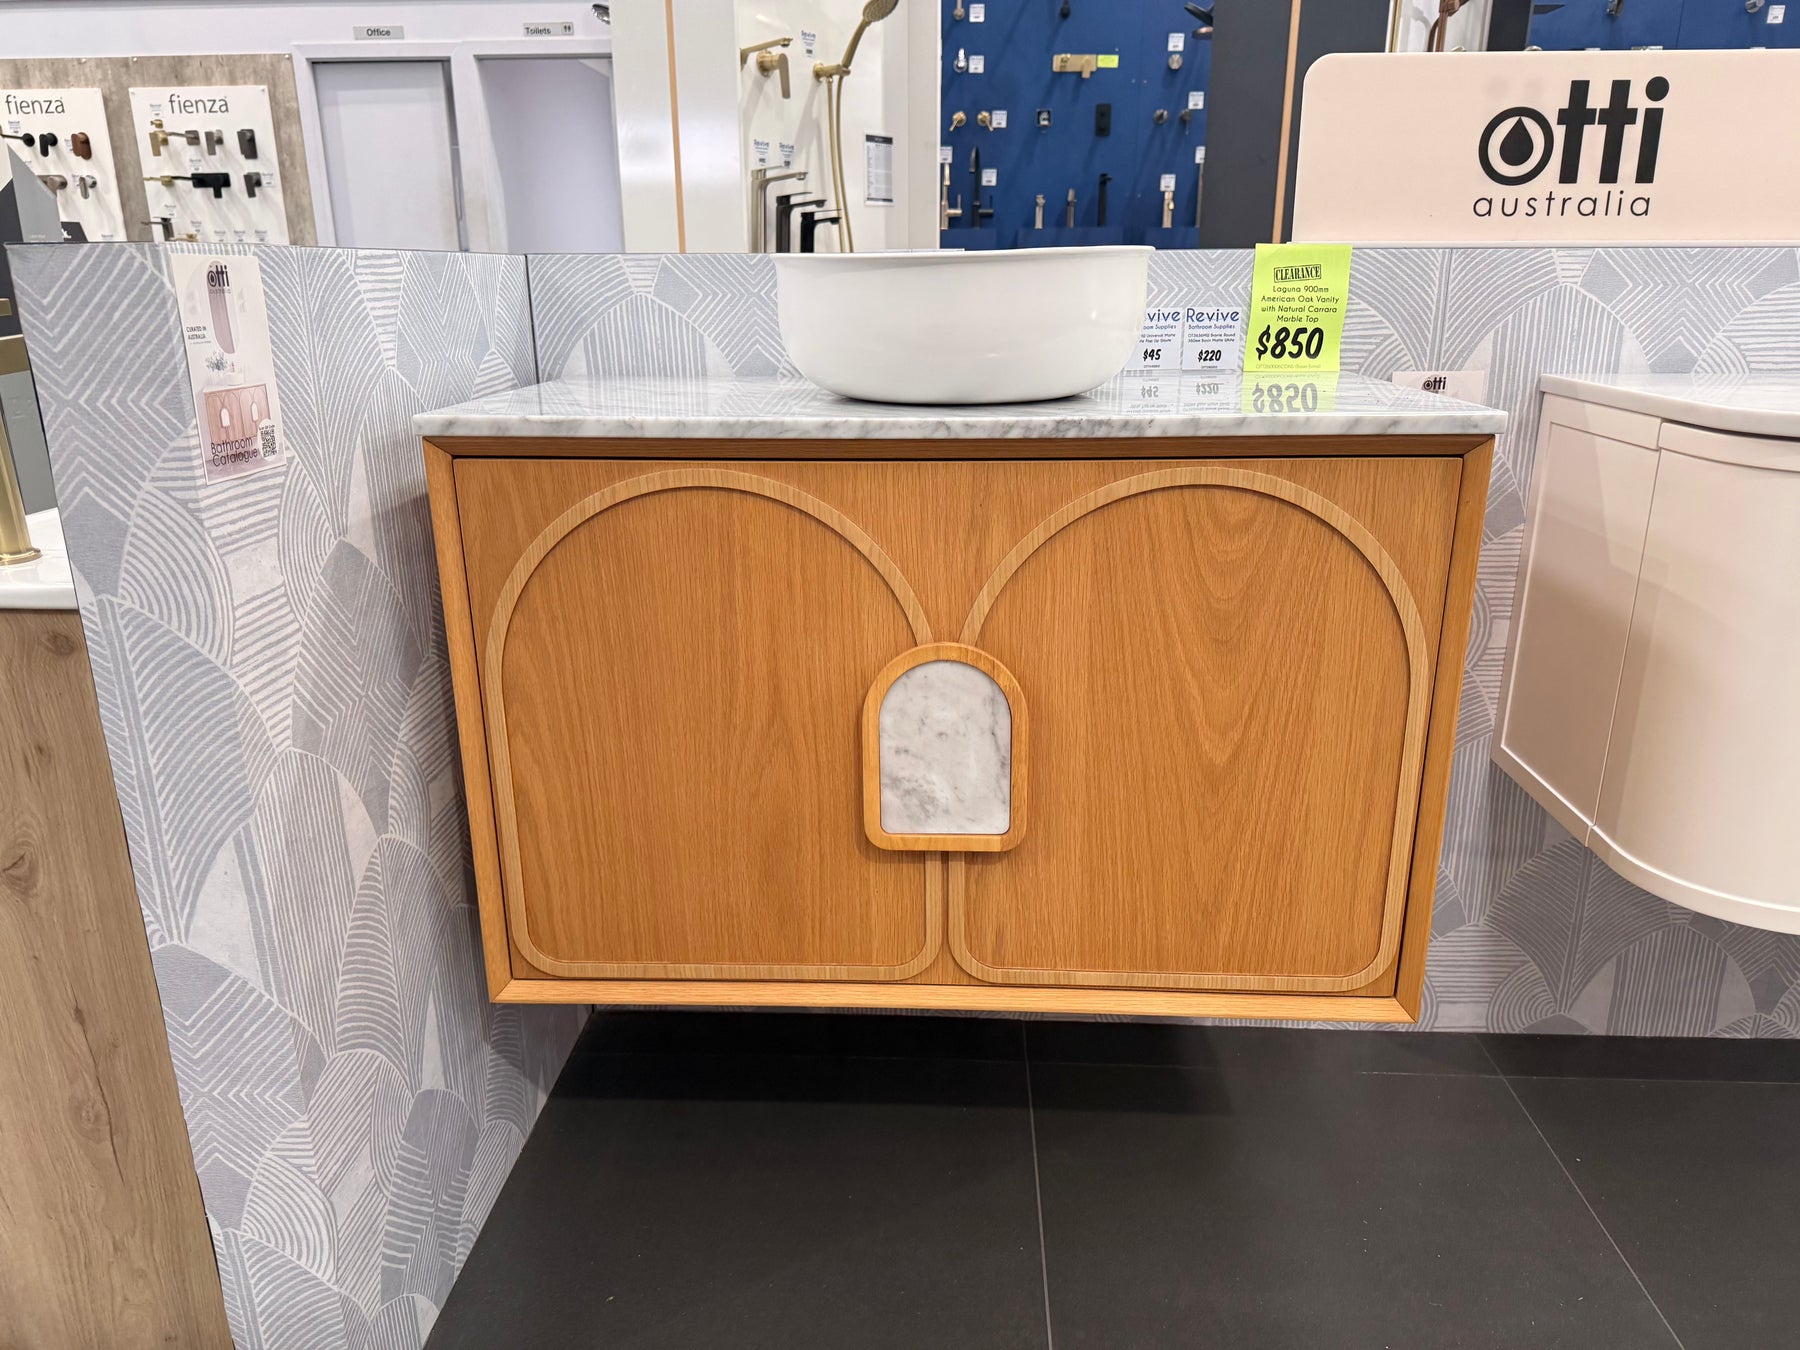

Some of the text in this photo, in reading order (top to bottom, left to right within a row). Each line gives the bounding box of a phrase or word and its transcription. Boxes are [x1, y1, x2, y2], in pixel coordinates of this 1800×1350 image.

[367, 28, 391, 36] Office
[525, 27, 551, 35] Toilets
[5, 94, 65, 115] fienza
[168, 93, 229, 114] fienza
[1479, 76, 1669, 186] otti
[1473, 190, 1651, 217] australia
[207, 264, 230, 287] otti
[1275, 266, 1320, 281] CLEARANCE
[1298, 295, 1314, 303] Oak
[1316, 296, 1340, 304] Vanity
[1147, 309, 1180, 323] vive
[1186, 308, 1240, 323] Revive
[1278, 305, 1305, 313] Natural
[1306, 315, 1319, 324] Top
[1256, 324, 1324, 361] $850
[1143, 348, 1162, 361] $45
[1198, 349, 1222, 363] $220
[1423, 376, 1447, 391] otti
[211, 437, 253, 455] Bathroom
[212, 448, 258, 467] Catalogue
